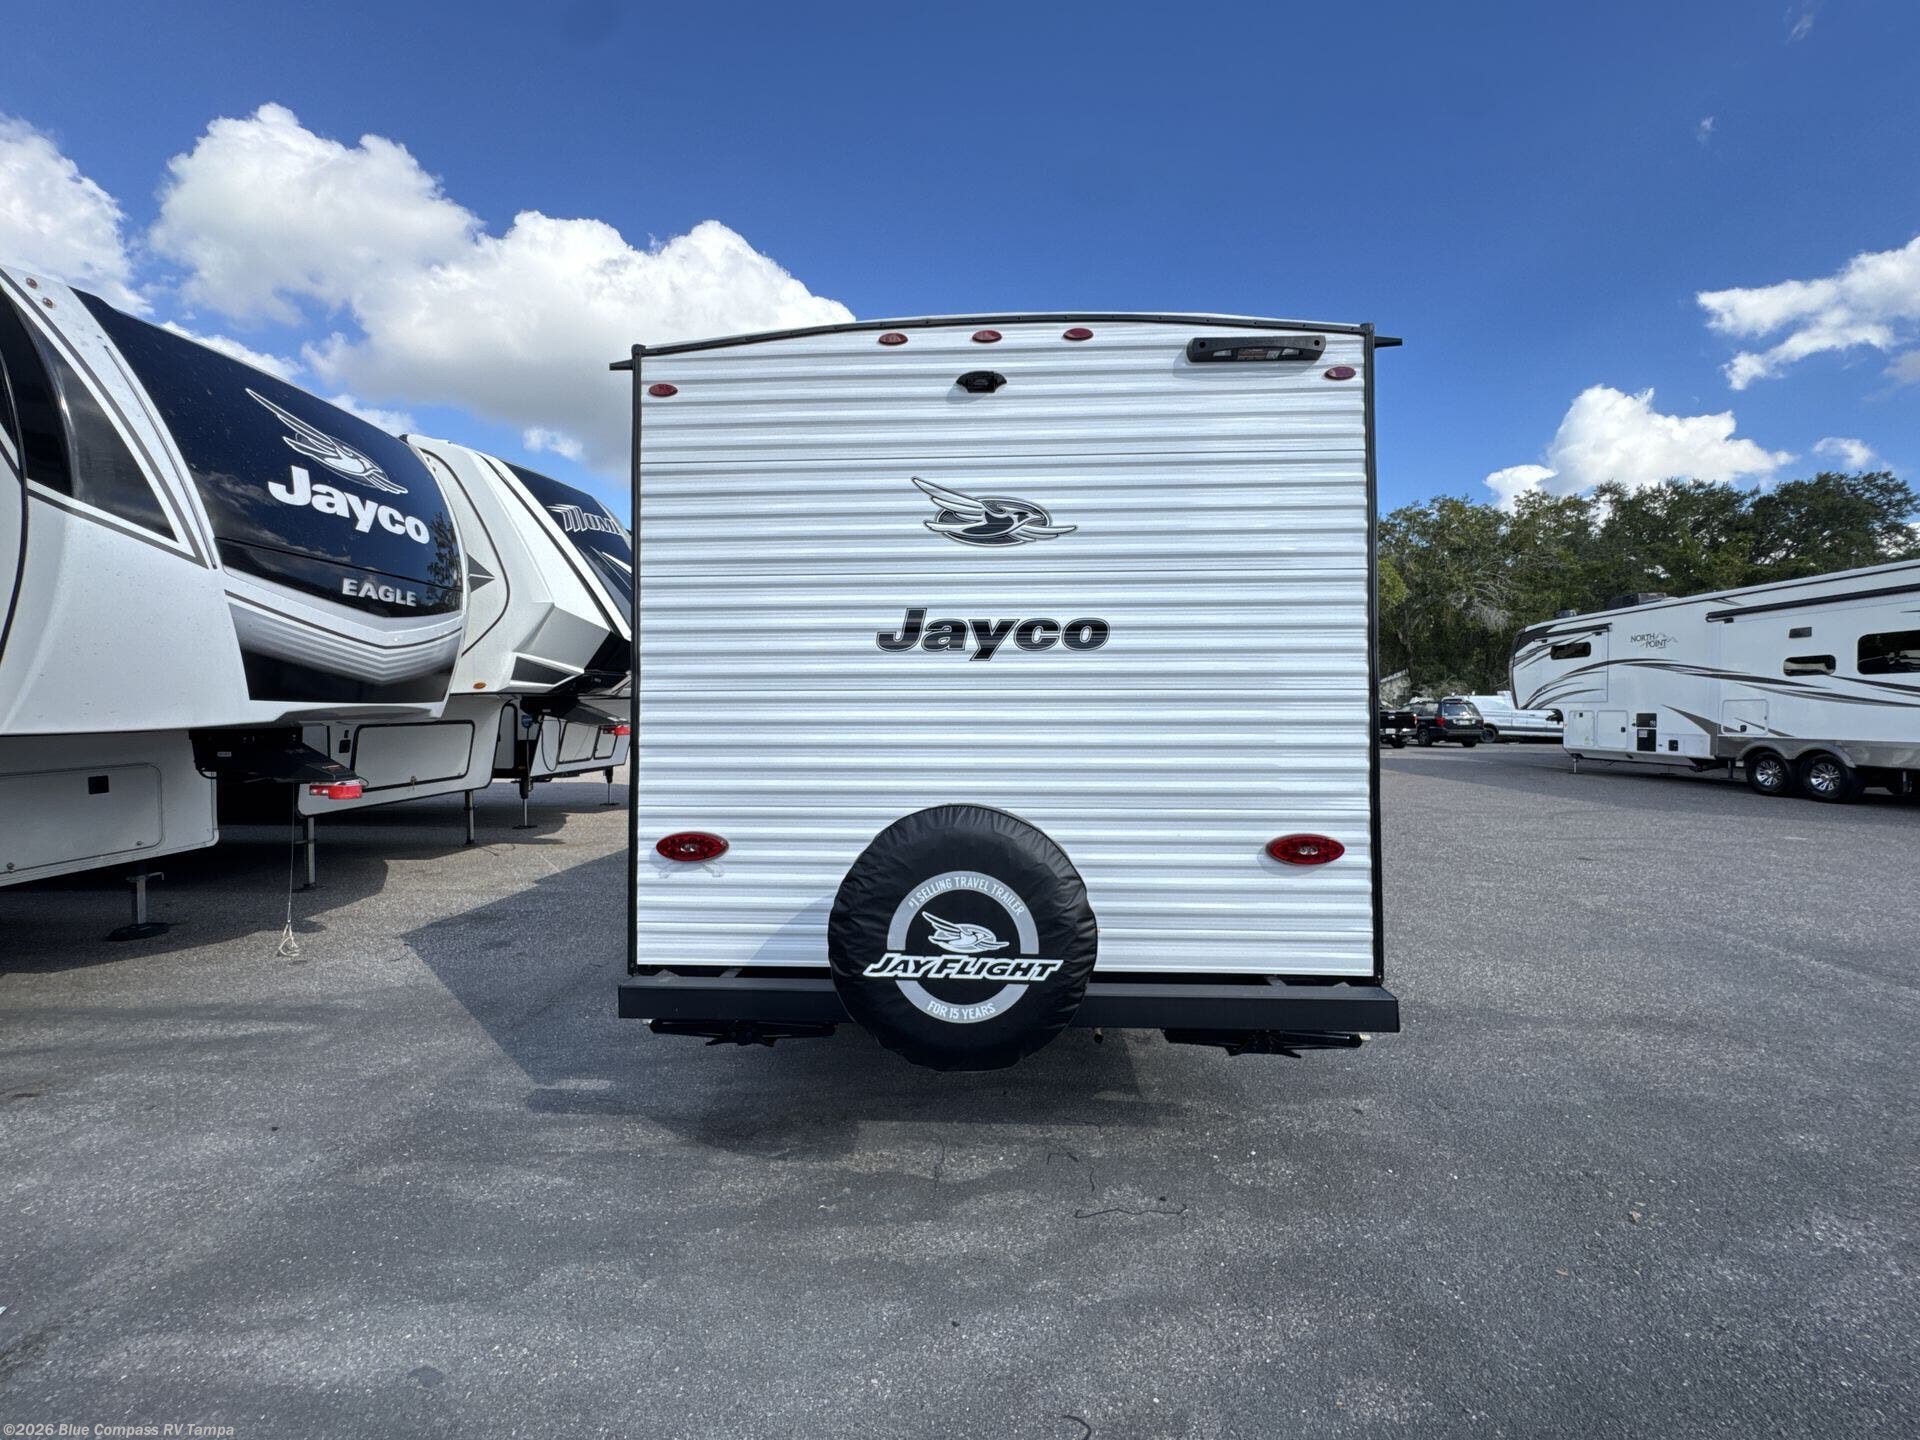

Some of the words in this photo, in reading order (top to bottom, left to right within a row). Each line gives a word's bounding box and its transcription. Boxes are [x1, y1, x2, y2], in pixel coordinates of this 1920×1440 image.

[267, 465, 430, 544] Jayco
[341, 577, 417, 607] EAGLE
[876, 608, 1111, 661] Jayco
[1630, 633, 1655, 642] NORTH
[916, 878, 952, 902] SELLING
[954, 876, 989, 892] TRAVEL
[991, 883, 1025, 916] TRAILER
[927, 1000, 947, 1018] FOR
[949, 1007, 960, 1020] 15
[962, 1002, 996, 1020] YEARS
